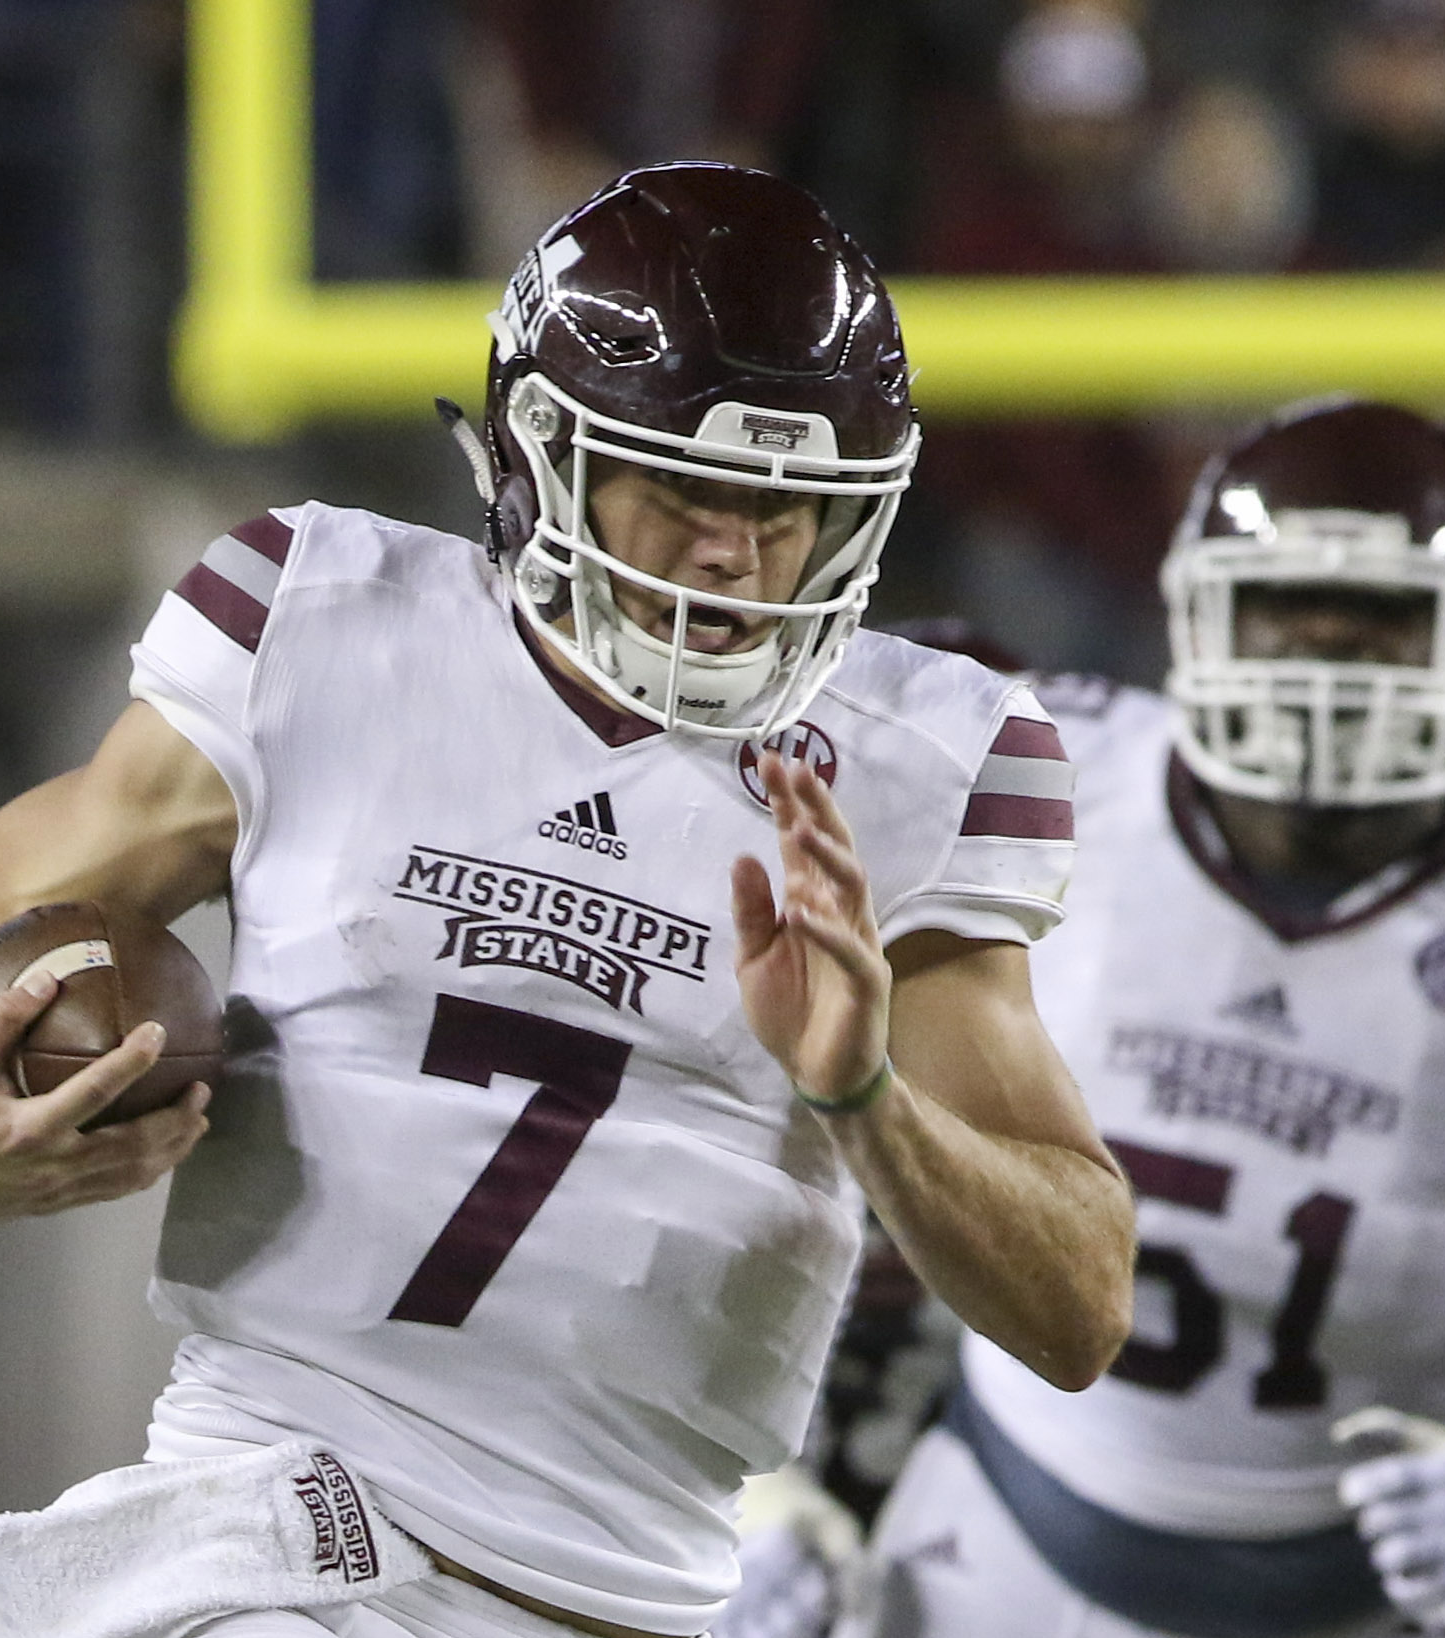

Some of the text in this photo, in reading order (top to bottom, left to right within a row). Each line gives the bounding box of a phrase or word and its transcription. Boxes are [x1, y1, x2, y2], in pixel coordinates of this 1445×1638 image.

[538, 820, 627, 861] adidas
[397, 854, 710, 970] MISSISSIPPI
[474, 930, 616, 997] STATE
[387, 992, 633, 1328] 7
[305, 1490, 333, 1559] STATE
[315, 1452, 373, 1582] MISSISSIPPI
